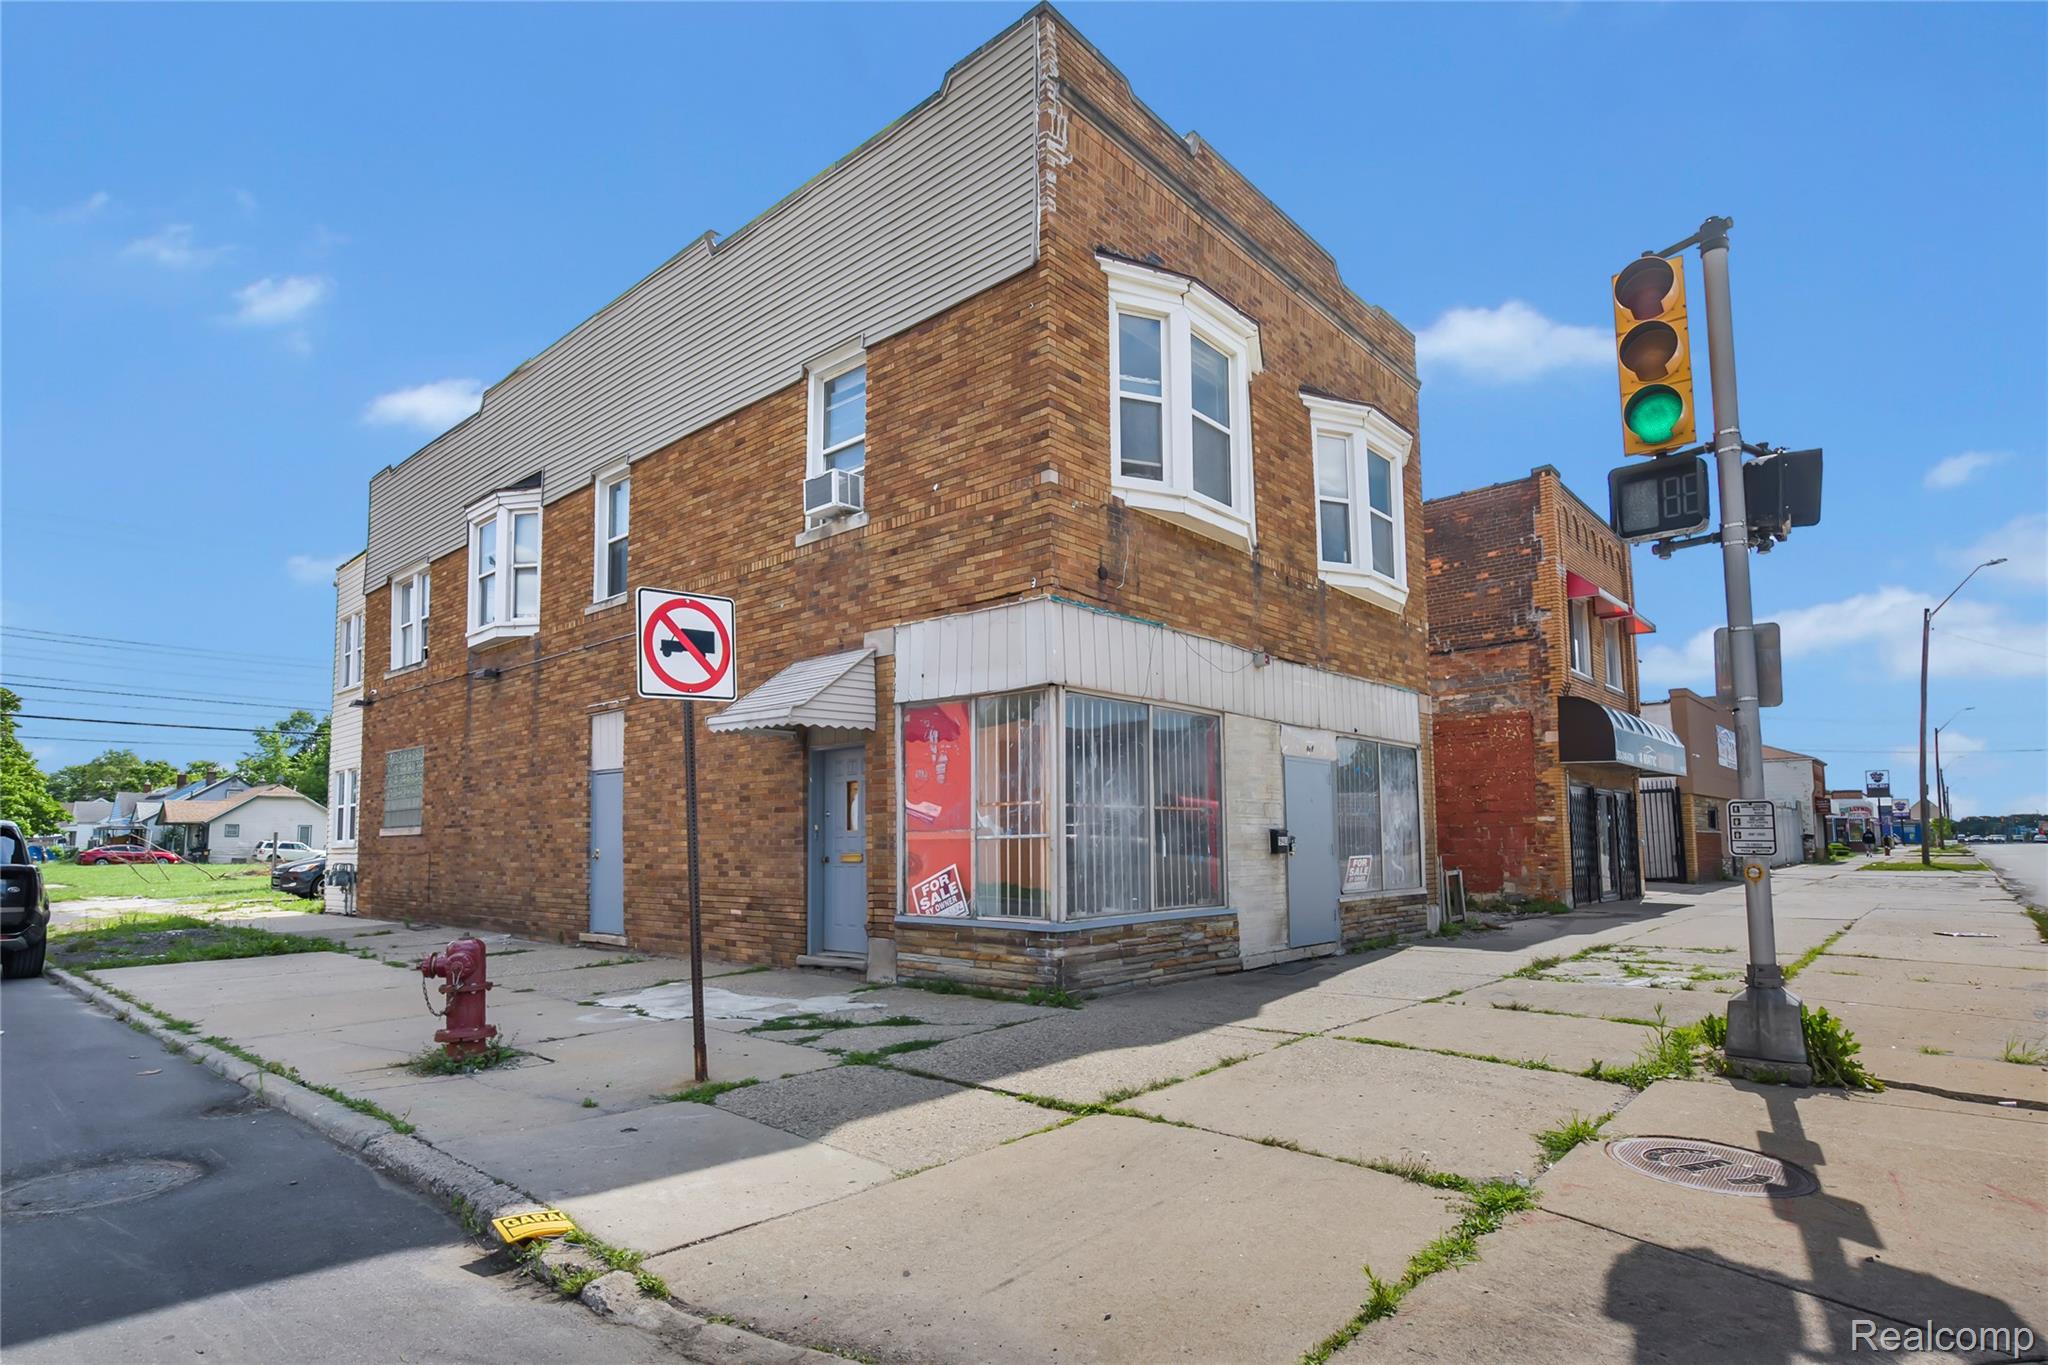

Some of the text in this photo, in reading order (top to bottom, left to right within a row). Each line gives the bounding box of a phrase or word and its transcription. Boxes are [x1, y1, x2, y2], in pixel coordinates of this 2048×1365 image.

[1352, 858, 1368, 867] FOR
[1349, 866, 1369, 877] SALE
[921, 874, 950, 896] FOR
[920, 881, 959, 910] SALE
[934, 895, 958, 912] OWNER
